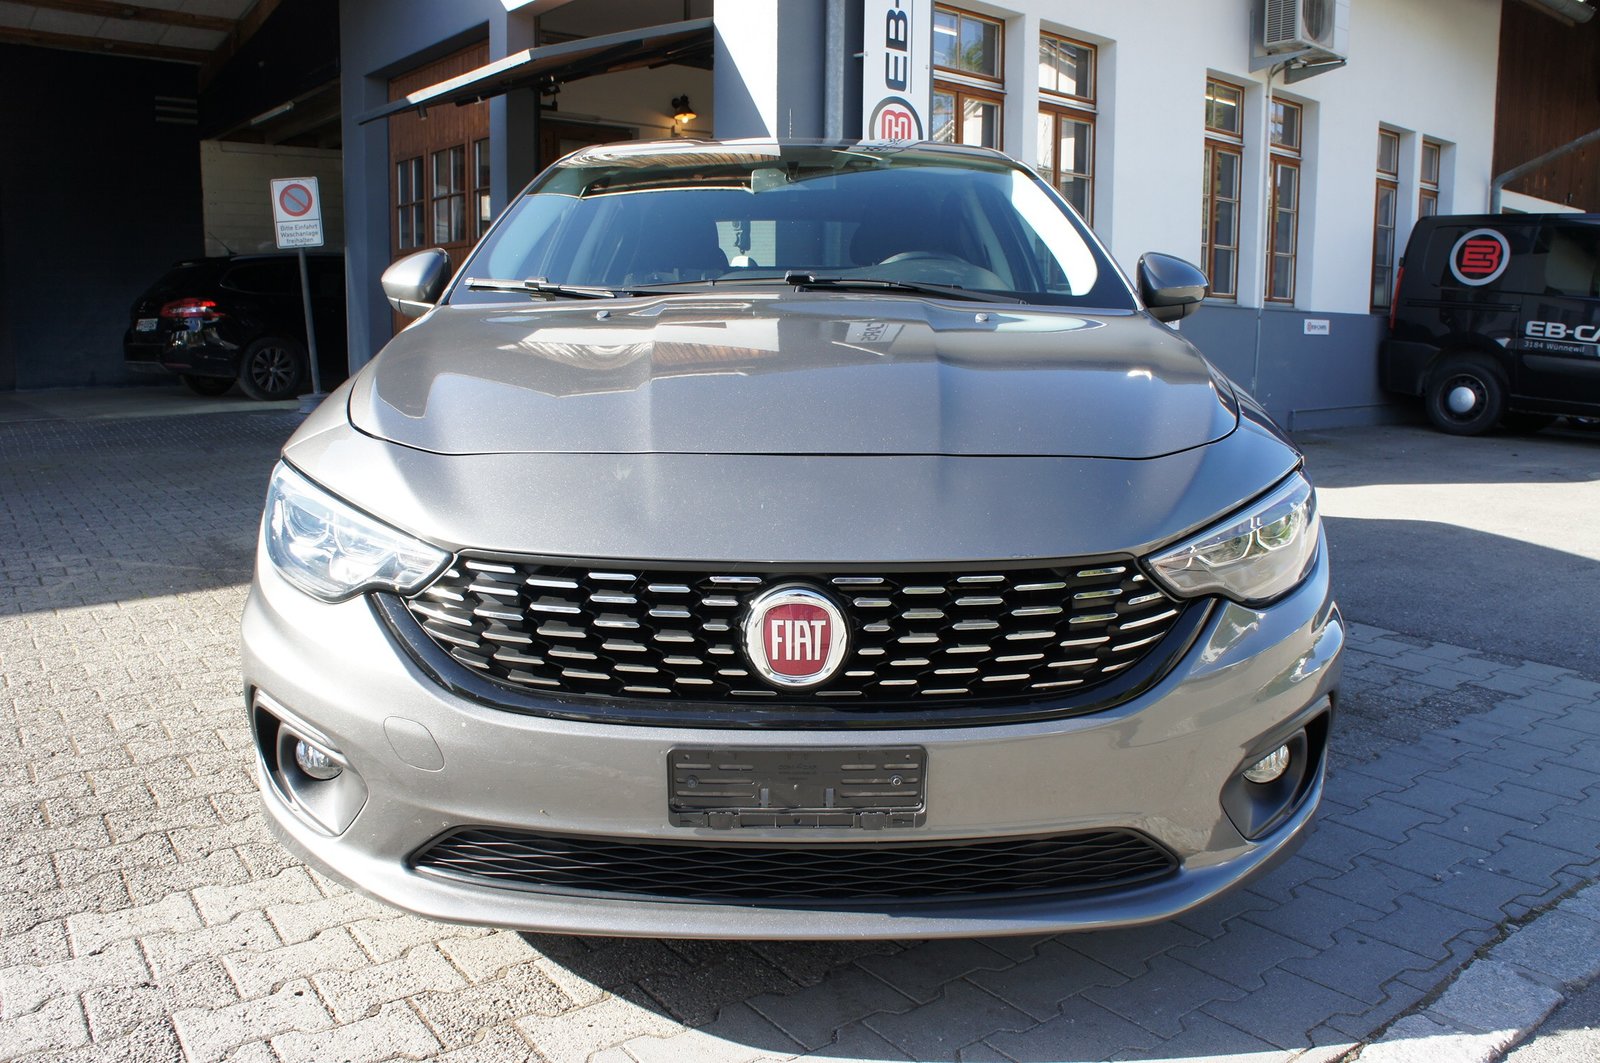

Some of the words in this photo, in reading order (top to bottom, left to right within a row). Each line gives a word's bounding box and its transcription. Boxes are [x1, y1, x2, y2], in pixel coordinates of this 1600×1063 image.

[1524, 340, 1544, 349] 3184
[1546, 343, 1585, 353] Wünnewil
[771, 619, 827, 661] FIAT
